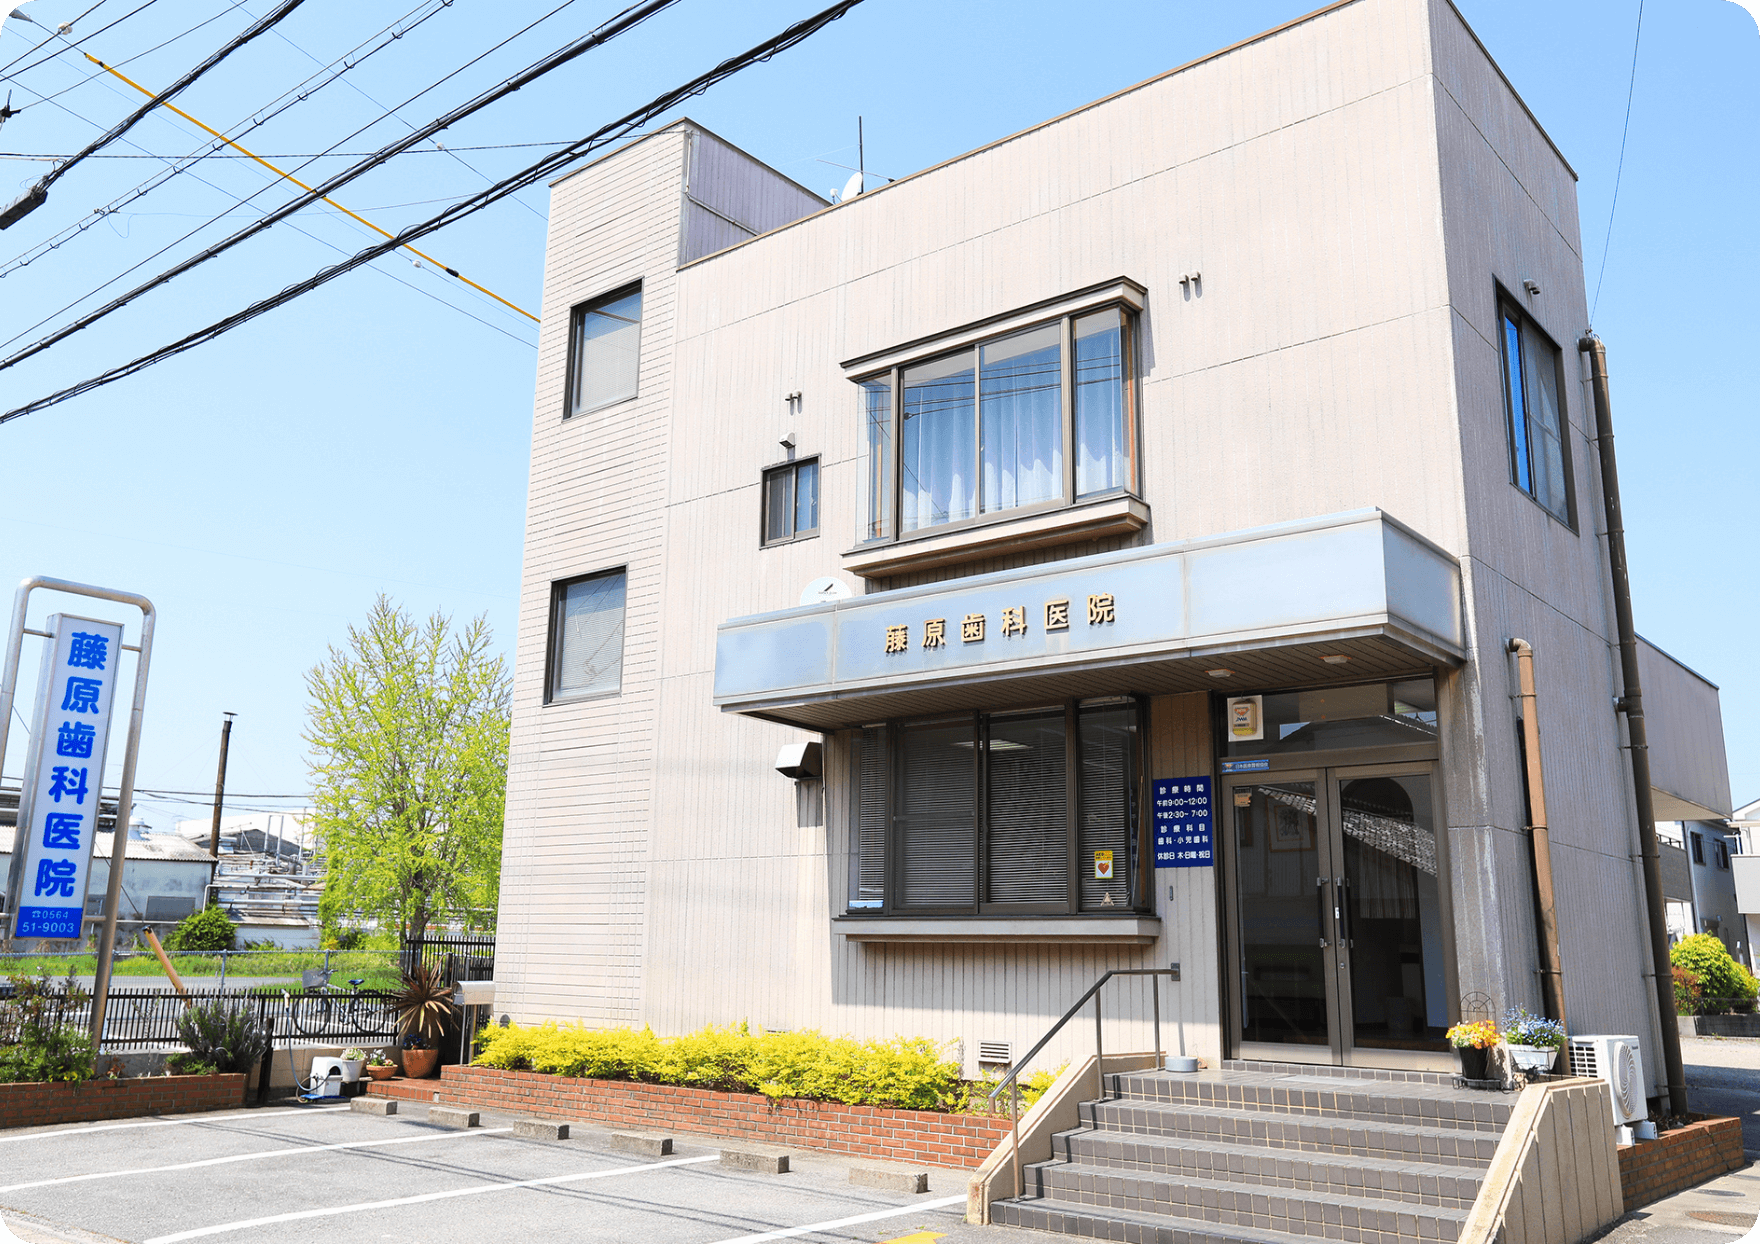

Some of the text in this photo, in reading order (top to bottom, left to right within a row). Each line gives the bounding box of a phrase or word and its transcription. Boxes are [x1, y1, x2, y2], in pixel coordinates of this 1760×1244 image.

[883, 592, 1116, 653] 藤原歯科医院
[34, 631, 109, 898] 藤原歯科医院
[21, 922, 75, 933] 51-9003
[42, 910, 69, 920] 0564
